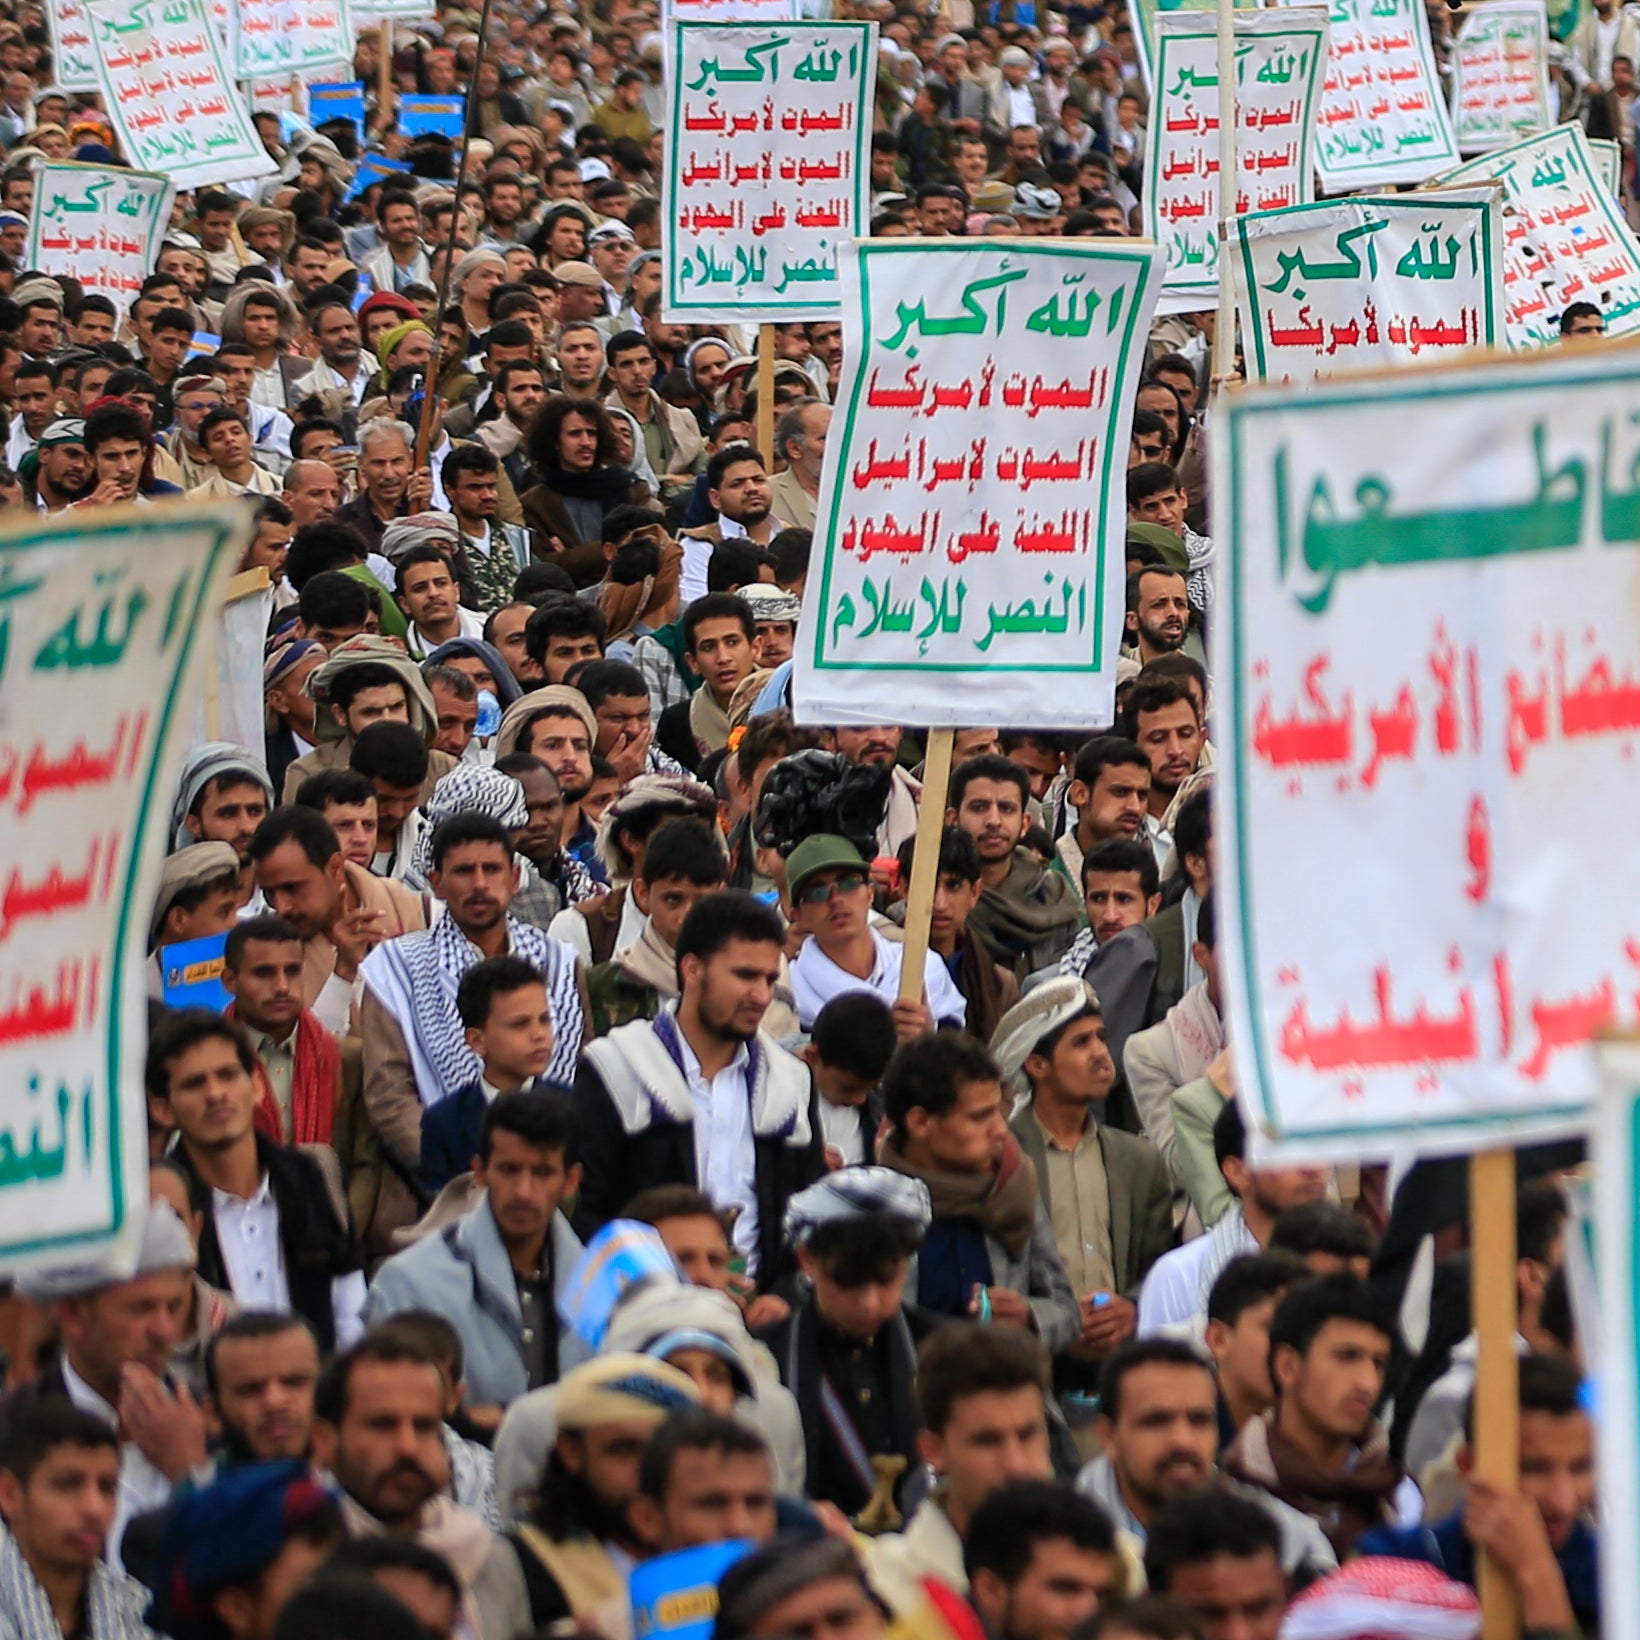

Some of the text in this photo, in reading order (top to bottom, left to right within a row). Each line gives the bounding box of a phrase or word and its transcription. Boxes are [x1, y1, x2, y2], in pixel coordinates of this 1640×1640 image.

[685, 30, 859, 97] الله أكبر
[1368, 30, 1415, 52] الموت
[1377, 60, 1423, 83] الموت
[684, 96, 854, 138] الموت لأمريكا
[1368, 99, 1390, 121] على
[1397, 92, 1430, 111] اللعنة
[681, 148, 851, 189] الموت لإسرائيل
[1324, 121, 1440, 159] النصر للإسلام
[679, 197, 850, 236] اللعنة على اليهود
[680, 236, 838, 300] لنصر للإسلام
[1262, 210, 1479, 301] الله أكبر
[877, 259, 1127, 358] الله أكبر
[1267, 295, 1479, 357] الموت لأمريكا
[865, 354, 1109, 419] الموت لأمريكا
[852, 433, 1098, 495] الموت لإسرائيل
[841, 506, 1092, 565] اللعنة على اليهود
[832, 570, 1087, 659] النصر للإسلام
[1251, 613, 1484, 794] الأمريكية
[1464, 792, 1493, 906] و
